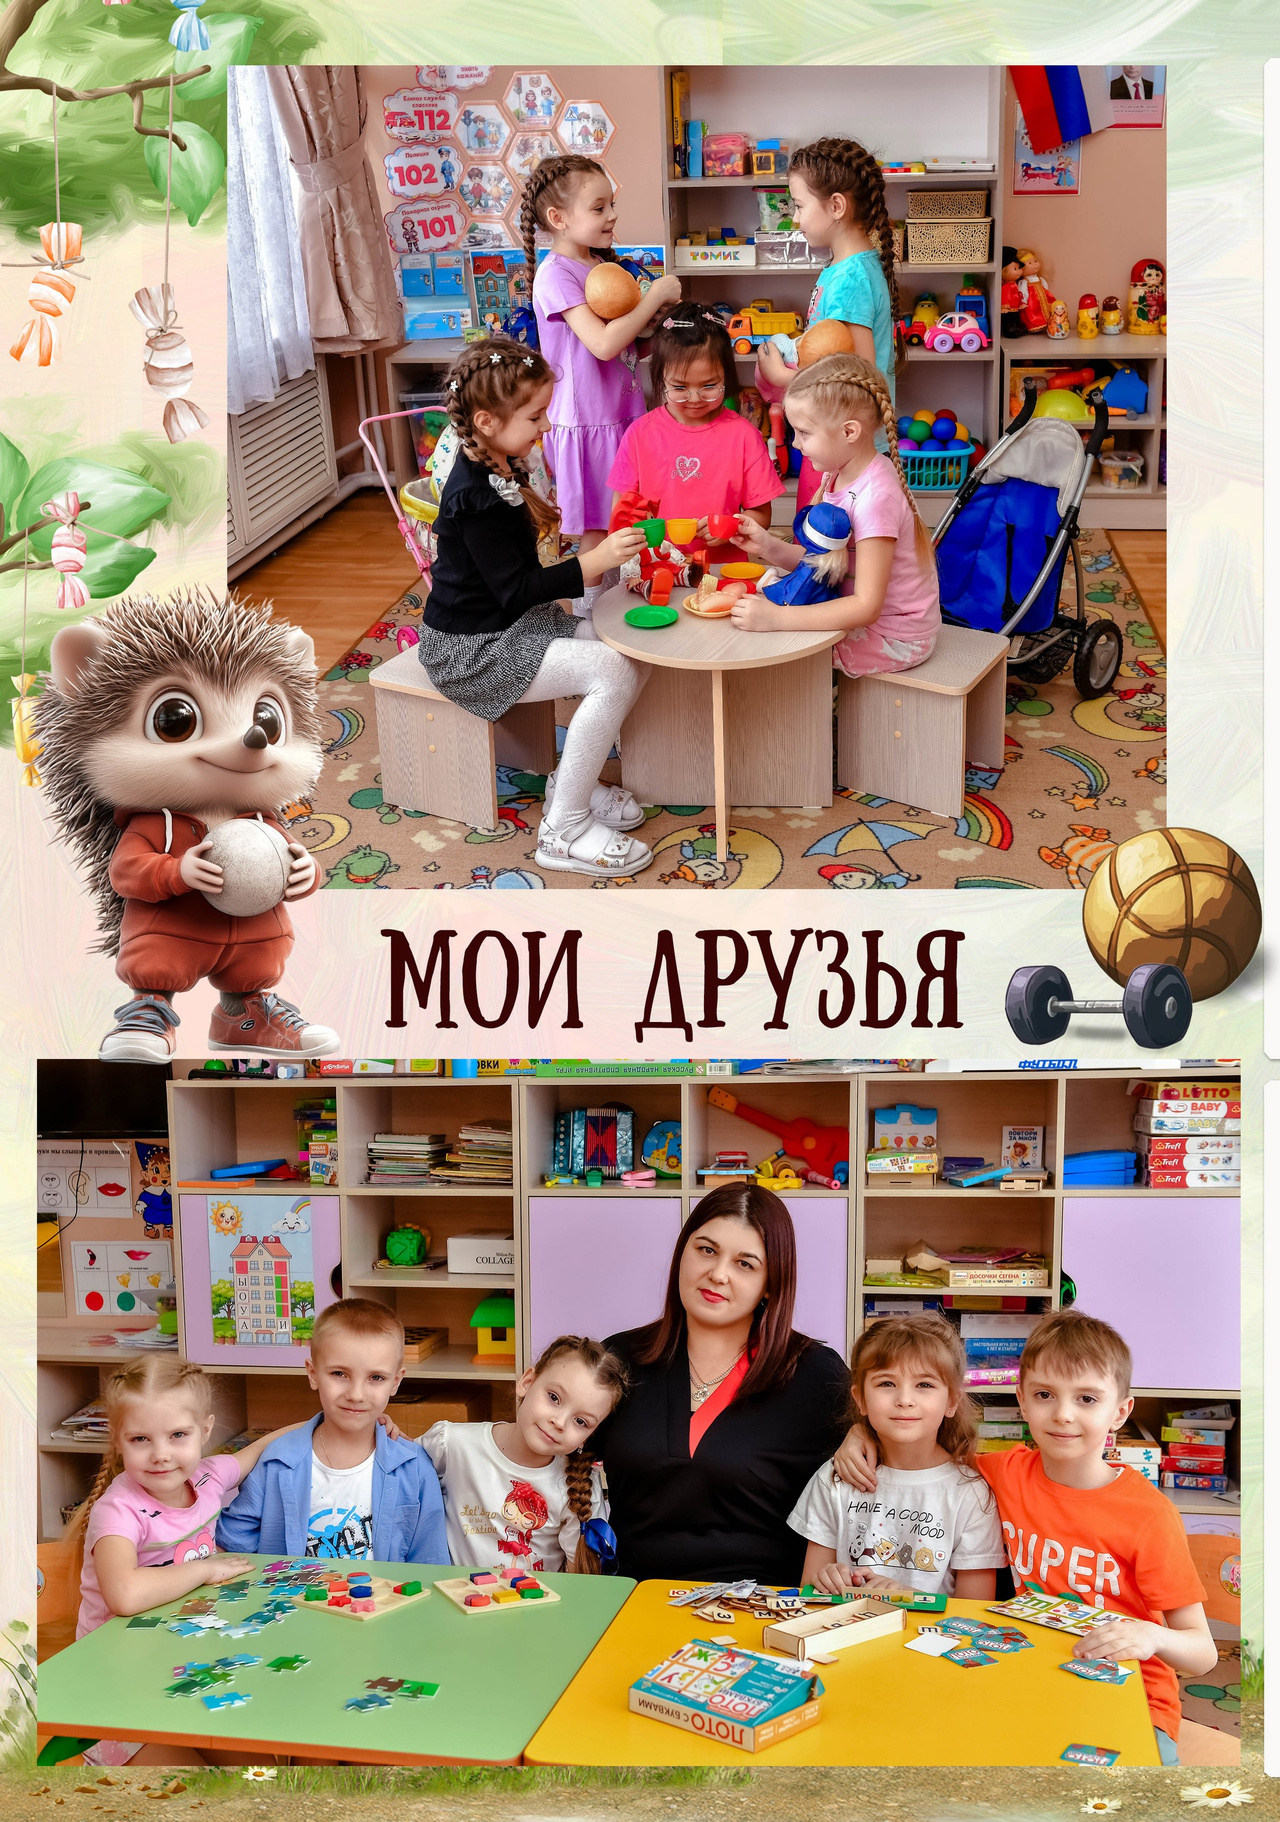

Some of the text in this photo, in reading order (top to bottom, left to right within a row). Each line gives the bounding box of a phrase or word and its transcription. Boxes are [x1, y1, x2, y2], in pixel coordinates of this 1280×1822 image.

[414, 109, 451, 130] 112
[394, 163, 438, 187] 102
[417, 215, 457, 240] 101
[690, 251, 740, 261] ТОМИК
[1191, 1103, 1221, 1111] BABY
[1188, 1119, 1219, 1128] BABY
[1164, 1142, 1181, 1150] Trefl
[1162, 1158, 1179, 1166] Trefl
[1164, 1175, 1182, 1183] Trefl
[238, 1278, 247, 1287] Ы
[239, 1292, 247, 1301] О
[240, 1306, 247, 1315] У
[241, 1321, 248, 1330] А
[280, 1321, 287, 1329] И
[847, 1501, 933, 1523] HAVE A GOOD
[910, 1524, 945, 1539] MOOD
[845, 1592, 890, 1602] ЛИМОН
[638, 1698, 682, 1721] БУКВАМИ
[707, 1694, 766, 1717] ЛОТО
[691, 1713, 744, 1745] ЛОТО
